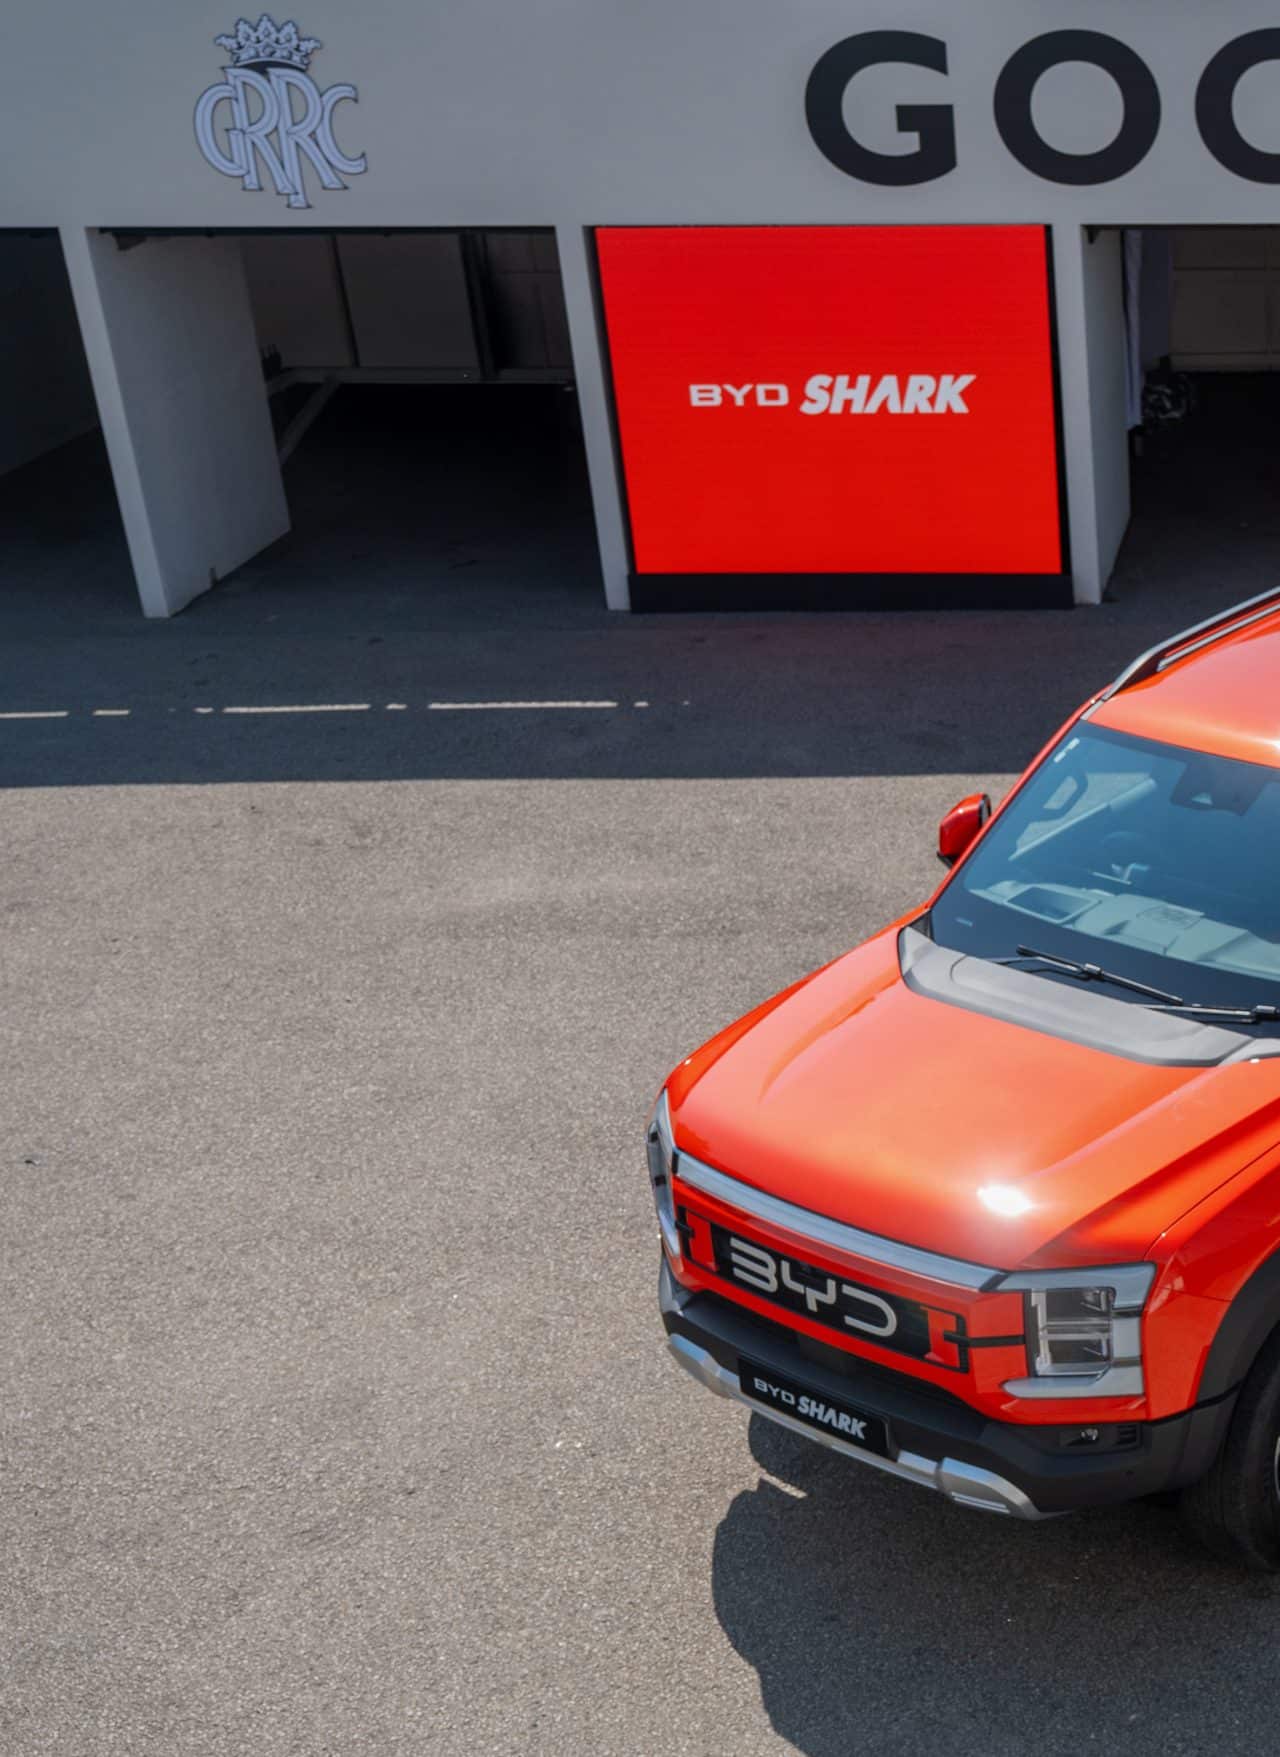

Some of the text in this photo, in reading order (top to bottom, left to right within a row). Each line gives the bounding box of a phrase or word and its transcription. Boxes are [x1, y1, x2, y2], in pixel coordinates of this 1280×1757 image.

[193, 66, 369, 209] GRRC
[688, 374, 977, 416] BYD SHARK
[729, 1236, 898, 1338] BYD
[752, 1377, 868, 1440] BYD SHARK
